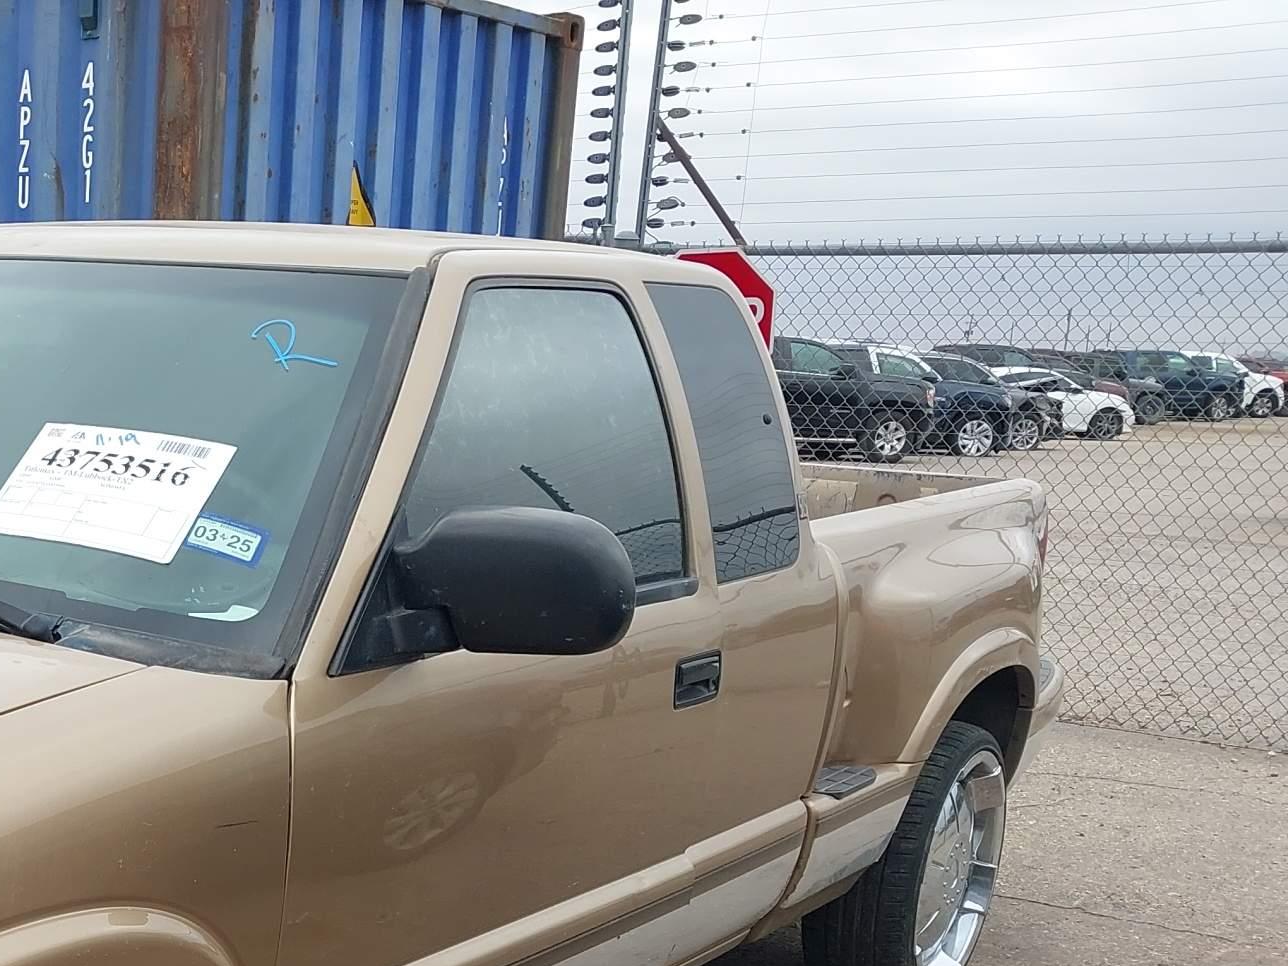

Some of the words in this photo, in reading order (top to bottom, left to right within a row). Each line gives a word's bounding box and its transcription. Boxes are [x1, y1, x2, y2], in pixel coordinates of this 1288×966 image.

[17, 69, 32, 209] APZU
[81, 61, 95, 203] 42G1
[41, 447, 198, 486] 43753516
[194, 525, 219, 542] 03
[226, 534, 254, 553] 25
